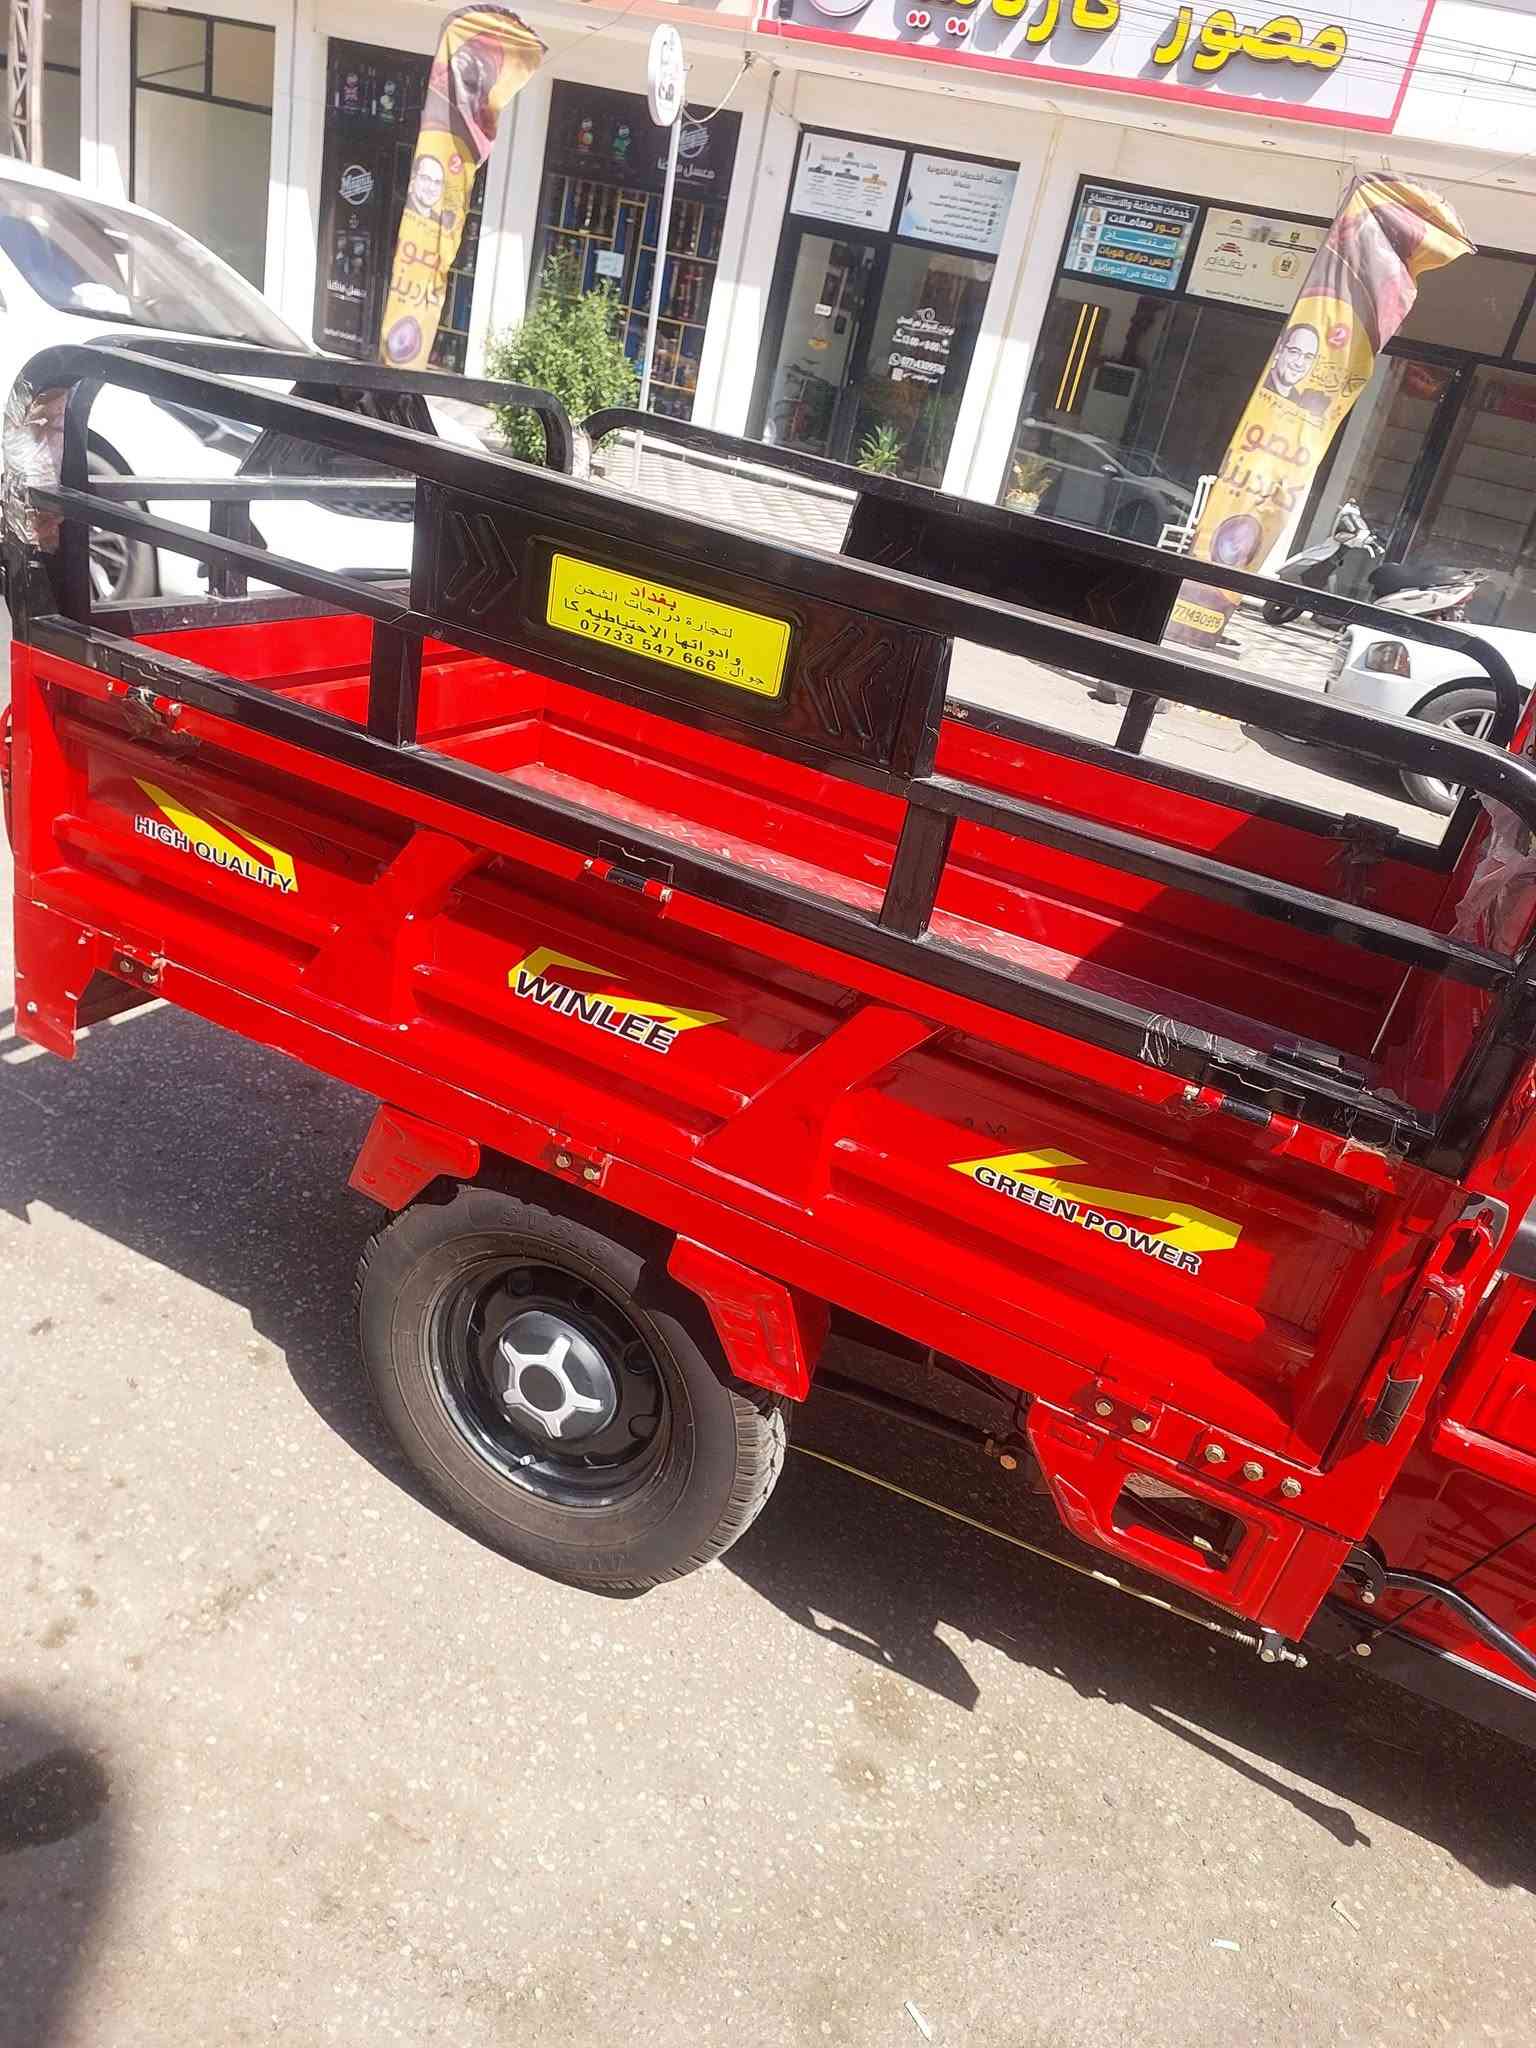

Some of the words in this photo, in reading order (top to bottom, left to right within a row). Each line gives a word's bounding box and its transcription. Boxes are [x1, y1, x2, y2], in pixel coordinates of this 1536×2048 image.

[1152, 6, 1347, 71] مصور
[1107, 213, 1154, 230] معاملات
[1153, 221, 1182, 234] صور
[574, 582, 618, 603] الشحن
[624, 597, 682, 623] دراجات
[630, 584, 678, 611] بغداد
[579, 618, 635, 646] 07733
[641, 637, 676, 659] 547
[682, 651, 717, 672] 666
[134, 814, 190, 852] HIGH
[195, 841, 293, 895] QUALITY
[513, 968, 680, 1054] WINLEE
[972, 1165, 1078, 1224] GREEN
[1081, 1210, 1202, 1275] POWER
